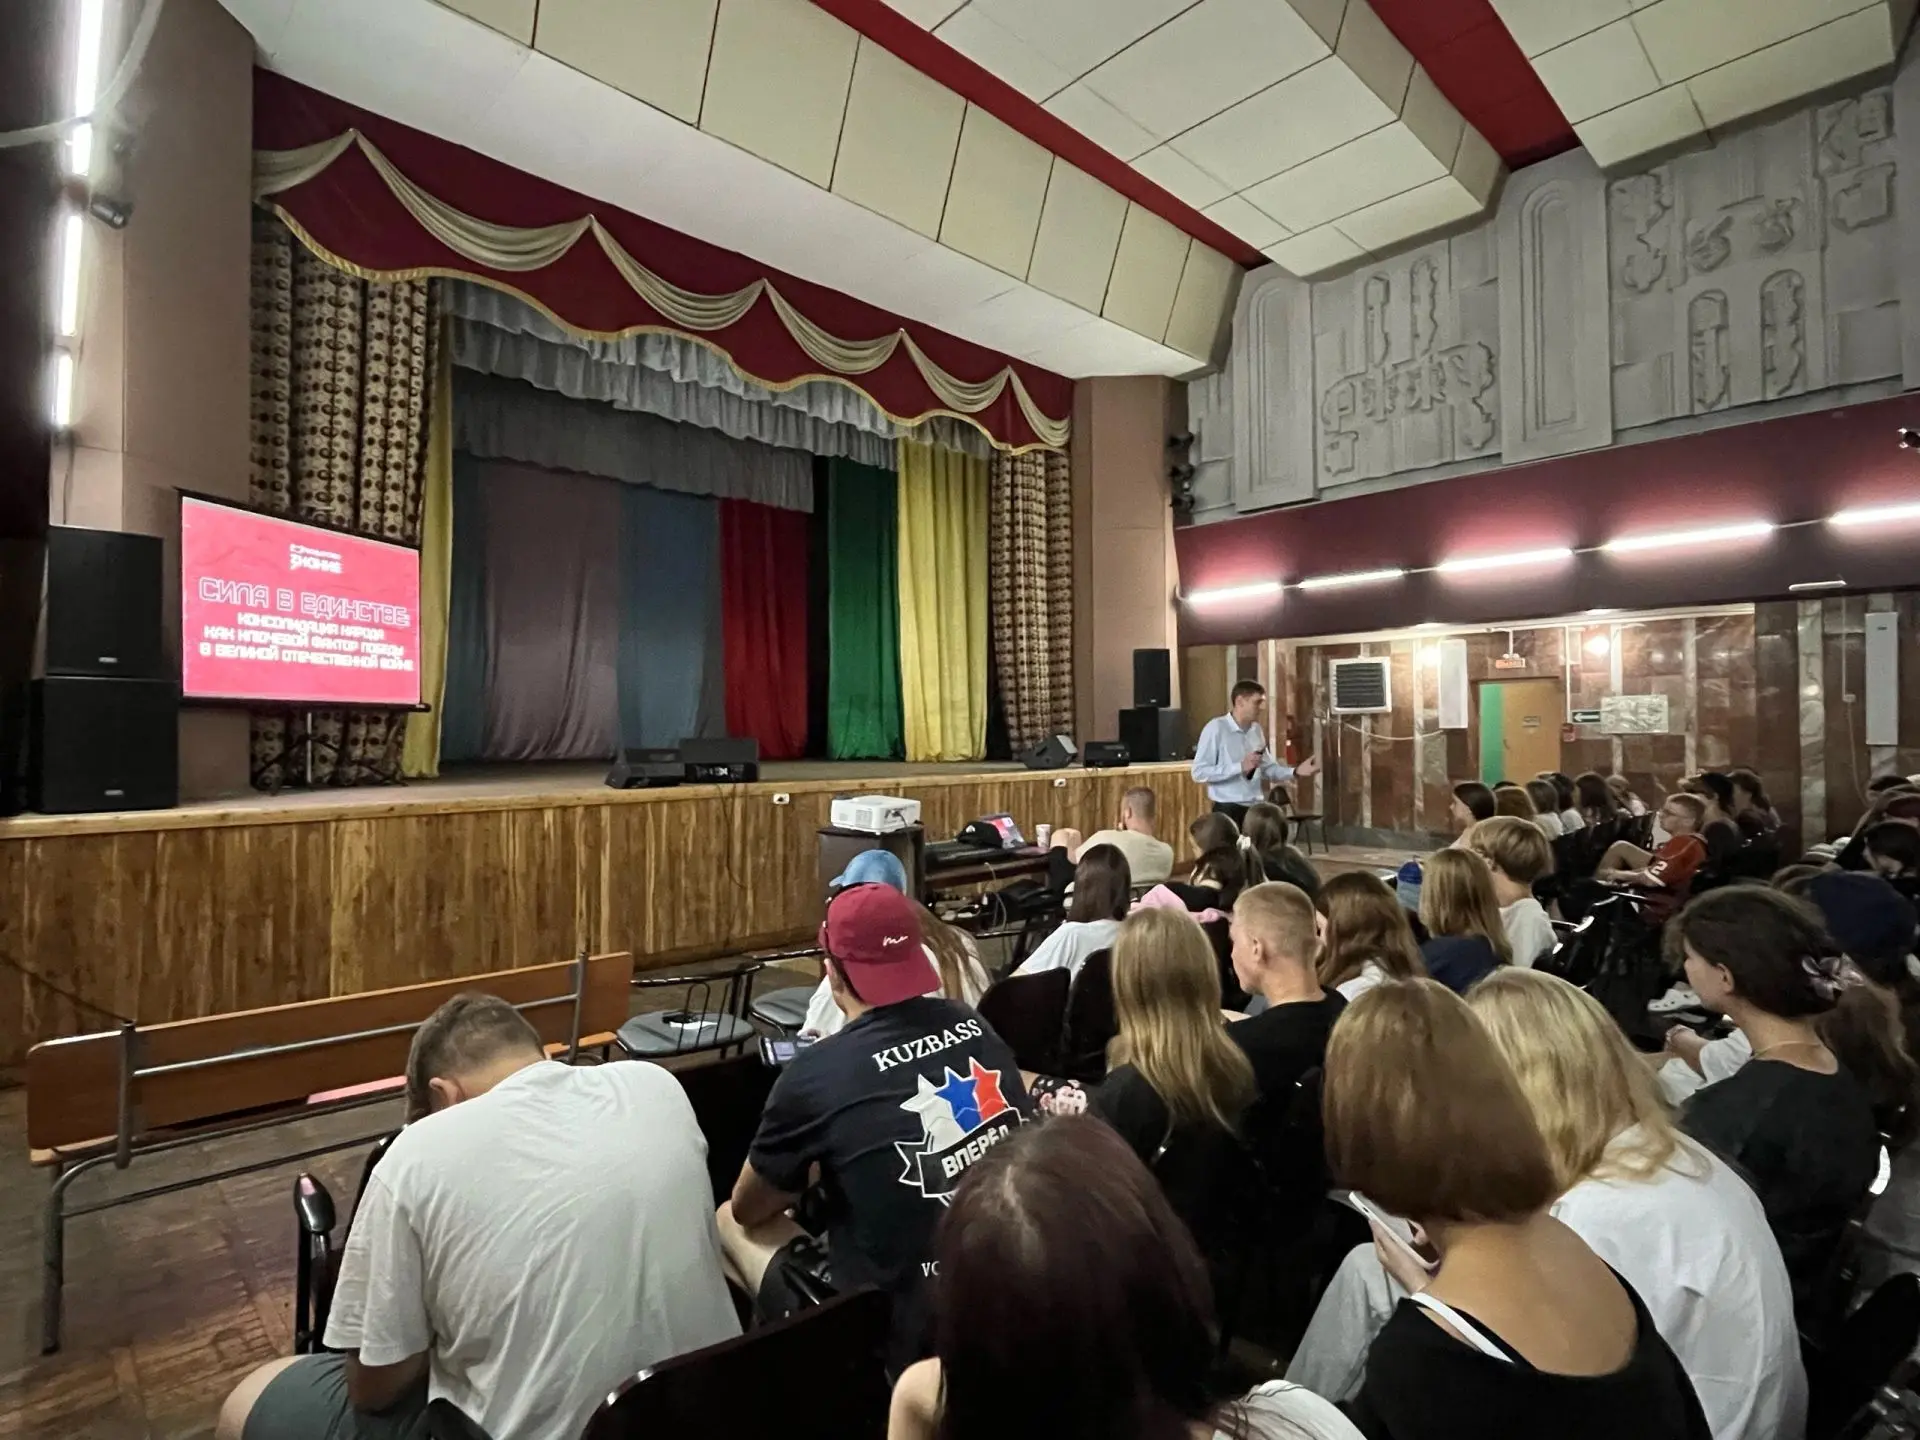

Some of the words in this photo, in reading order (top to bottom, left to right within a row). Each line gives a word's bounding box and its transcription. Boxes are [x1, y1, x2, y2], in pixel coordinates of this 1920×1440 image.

[200, 577, 269, 609] СИЛА
[278, 588, 294, 611] В
[302, 593, 411, 627] ЕДИНСТВЕ
[238, 612, 339, 636] КОНСОЛИДАЦИЯ
[200, 642, 212, 656] В
[216, 644, 279, 661] ВЕЛИКОЙ
[204, 625, 236, 641] КАК
[238, 629, 309, 648] КЛЮЧЕВОЙ
[312, 636, 359, 652] ФАКТОР
[872, 1019, 983, 1072] KUZBASS
